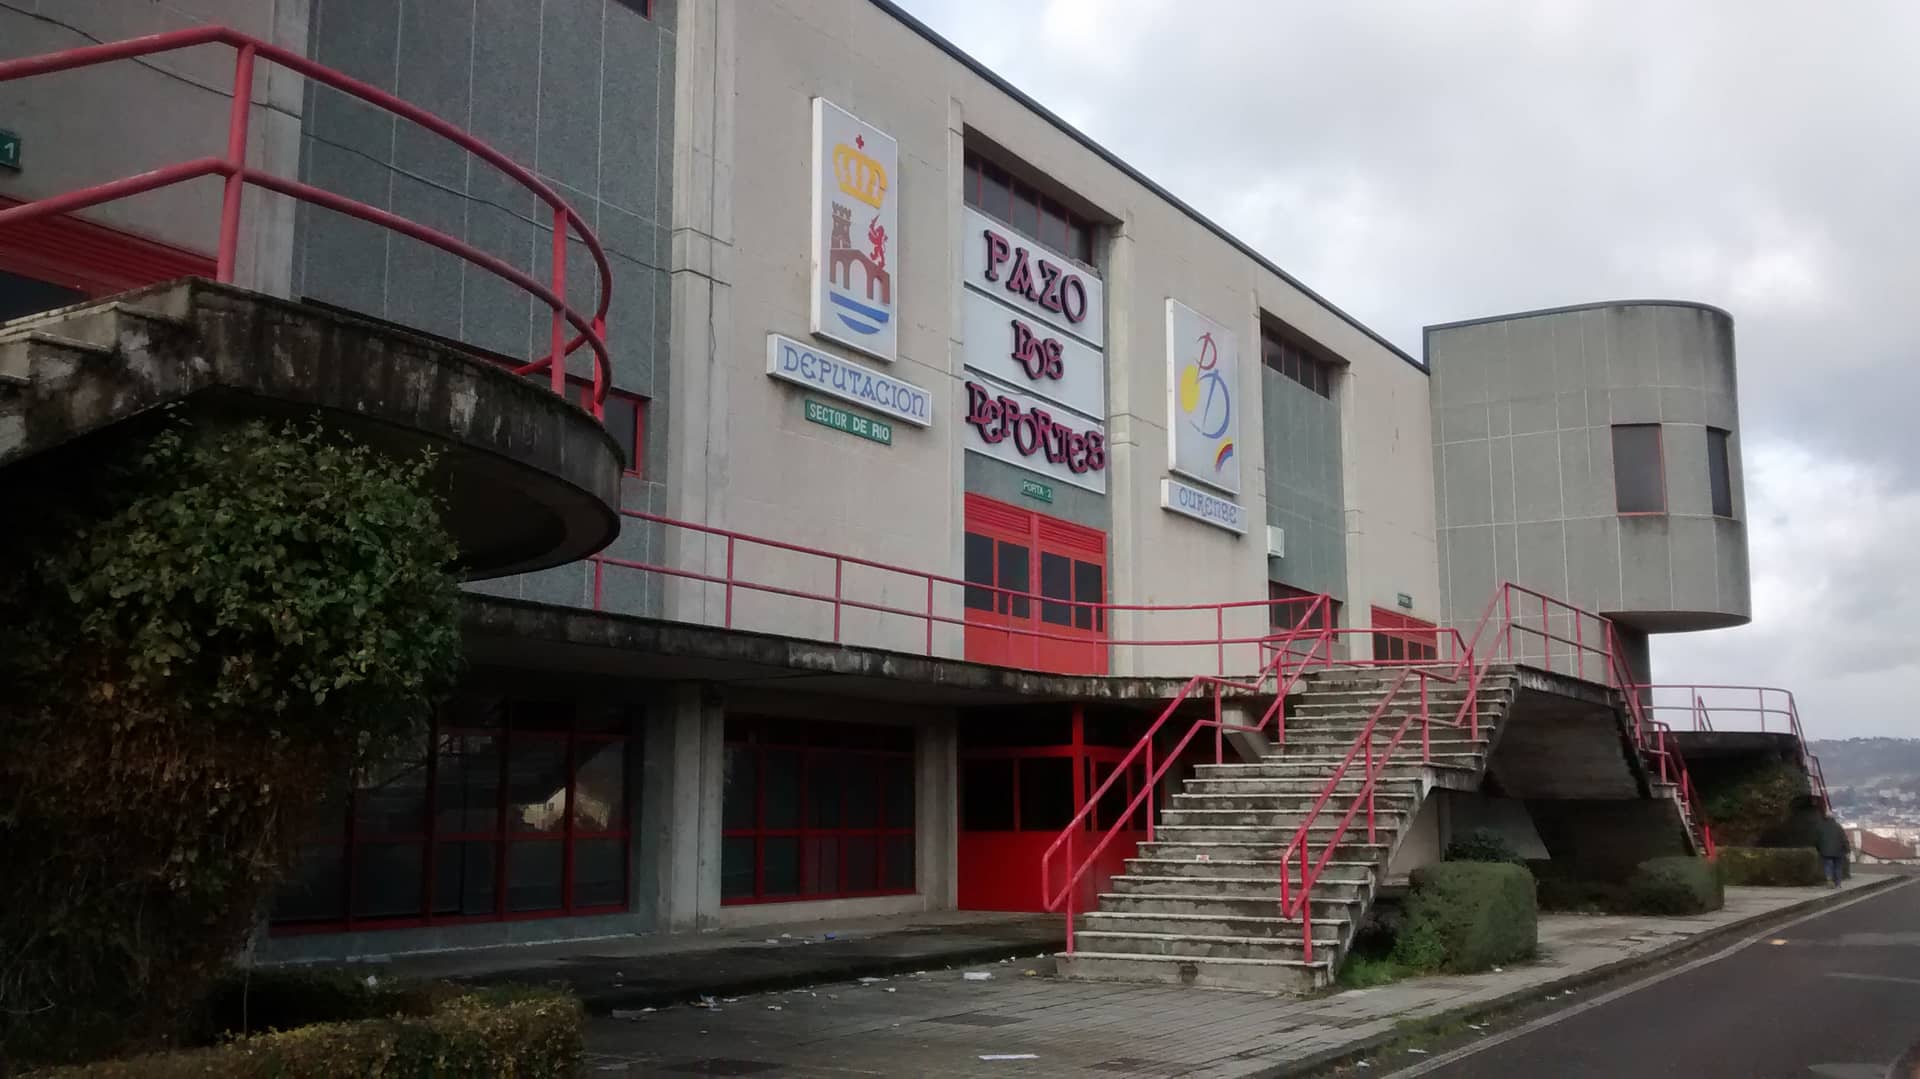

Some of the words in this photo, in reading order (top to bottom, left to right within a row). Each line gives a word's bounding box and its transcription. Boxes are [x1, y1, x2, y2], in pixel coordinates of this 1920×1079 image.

[4, 142, 15, 159] 1
[984, 229, 1088, 323] PAZO
[1011, 319, 1064, 380] DOS
[783, 345, 925, 417] DEPUTACION
[809, 403, 847, 429] SECTOR
[852, 416, 868, 434] DE
[871, 423, 890, 441] RIO
[965, 381, 1105, 474] DEPORTES
[1178, 486, 1238, 525] OURENSE
